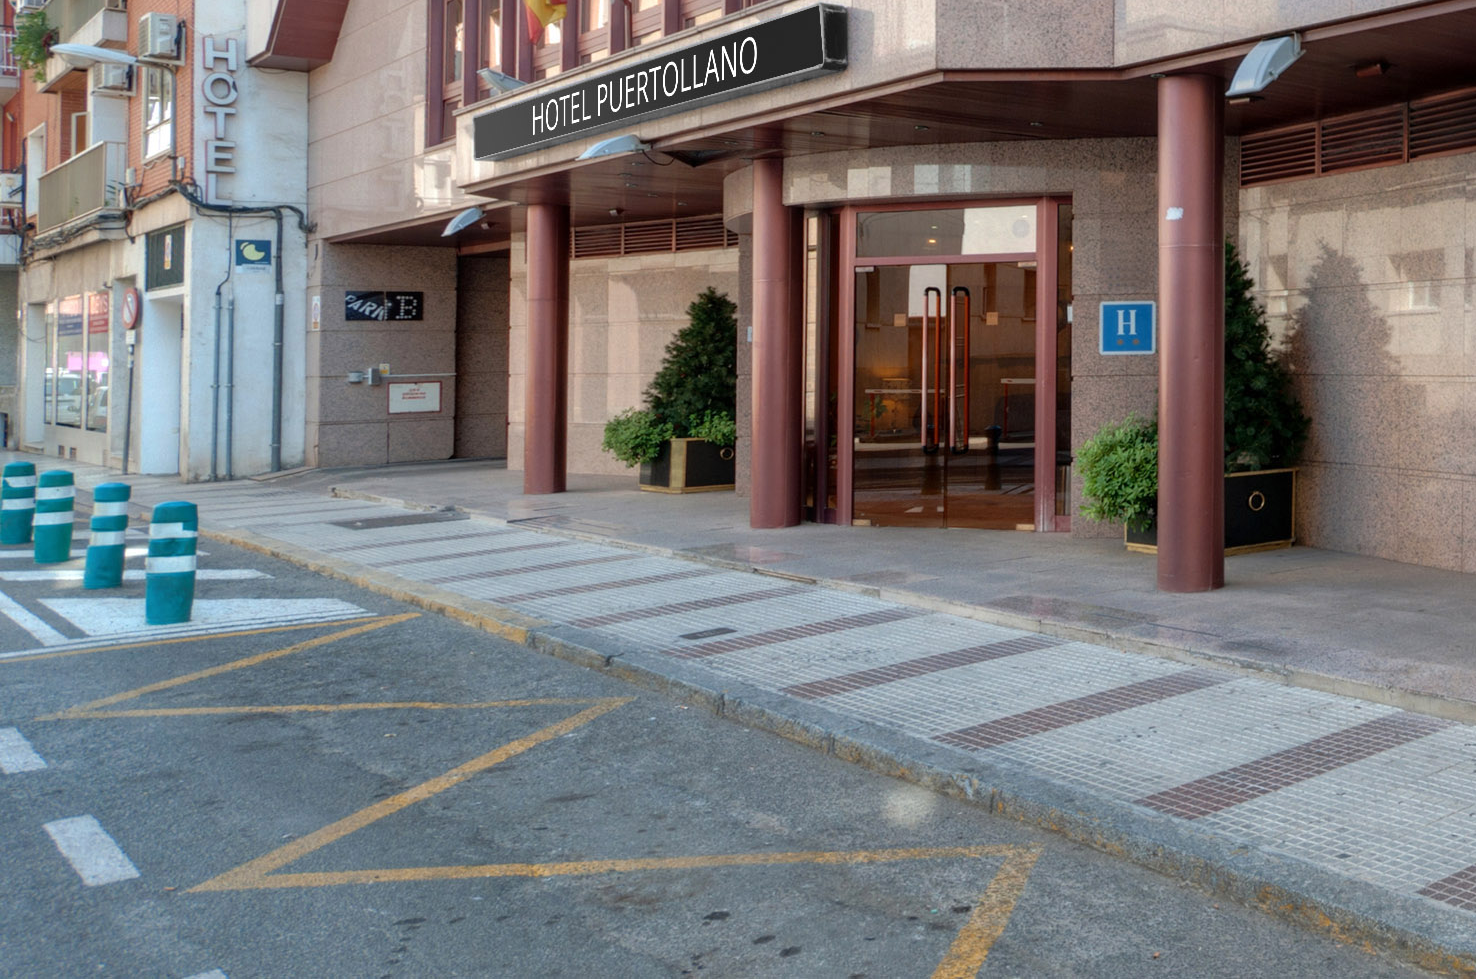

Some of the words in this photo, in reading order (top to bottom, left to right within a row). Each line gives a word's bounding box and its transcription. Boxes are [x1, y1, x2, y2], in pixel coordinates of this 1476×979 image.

[202, 36, 239, 207] HOTEL
[532, 90, 592, 136] HOTEL
[597, 36, 758, 117] PUERTOLLANO
[1116, 309, 1137, 335] H
